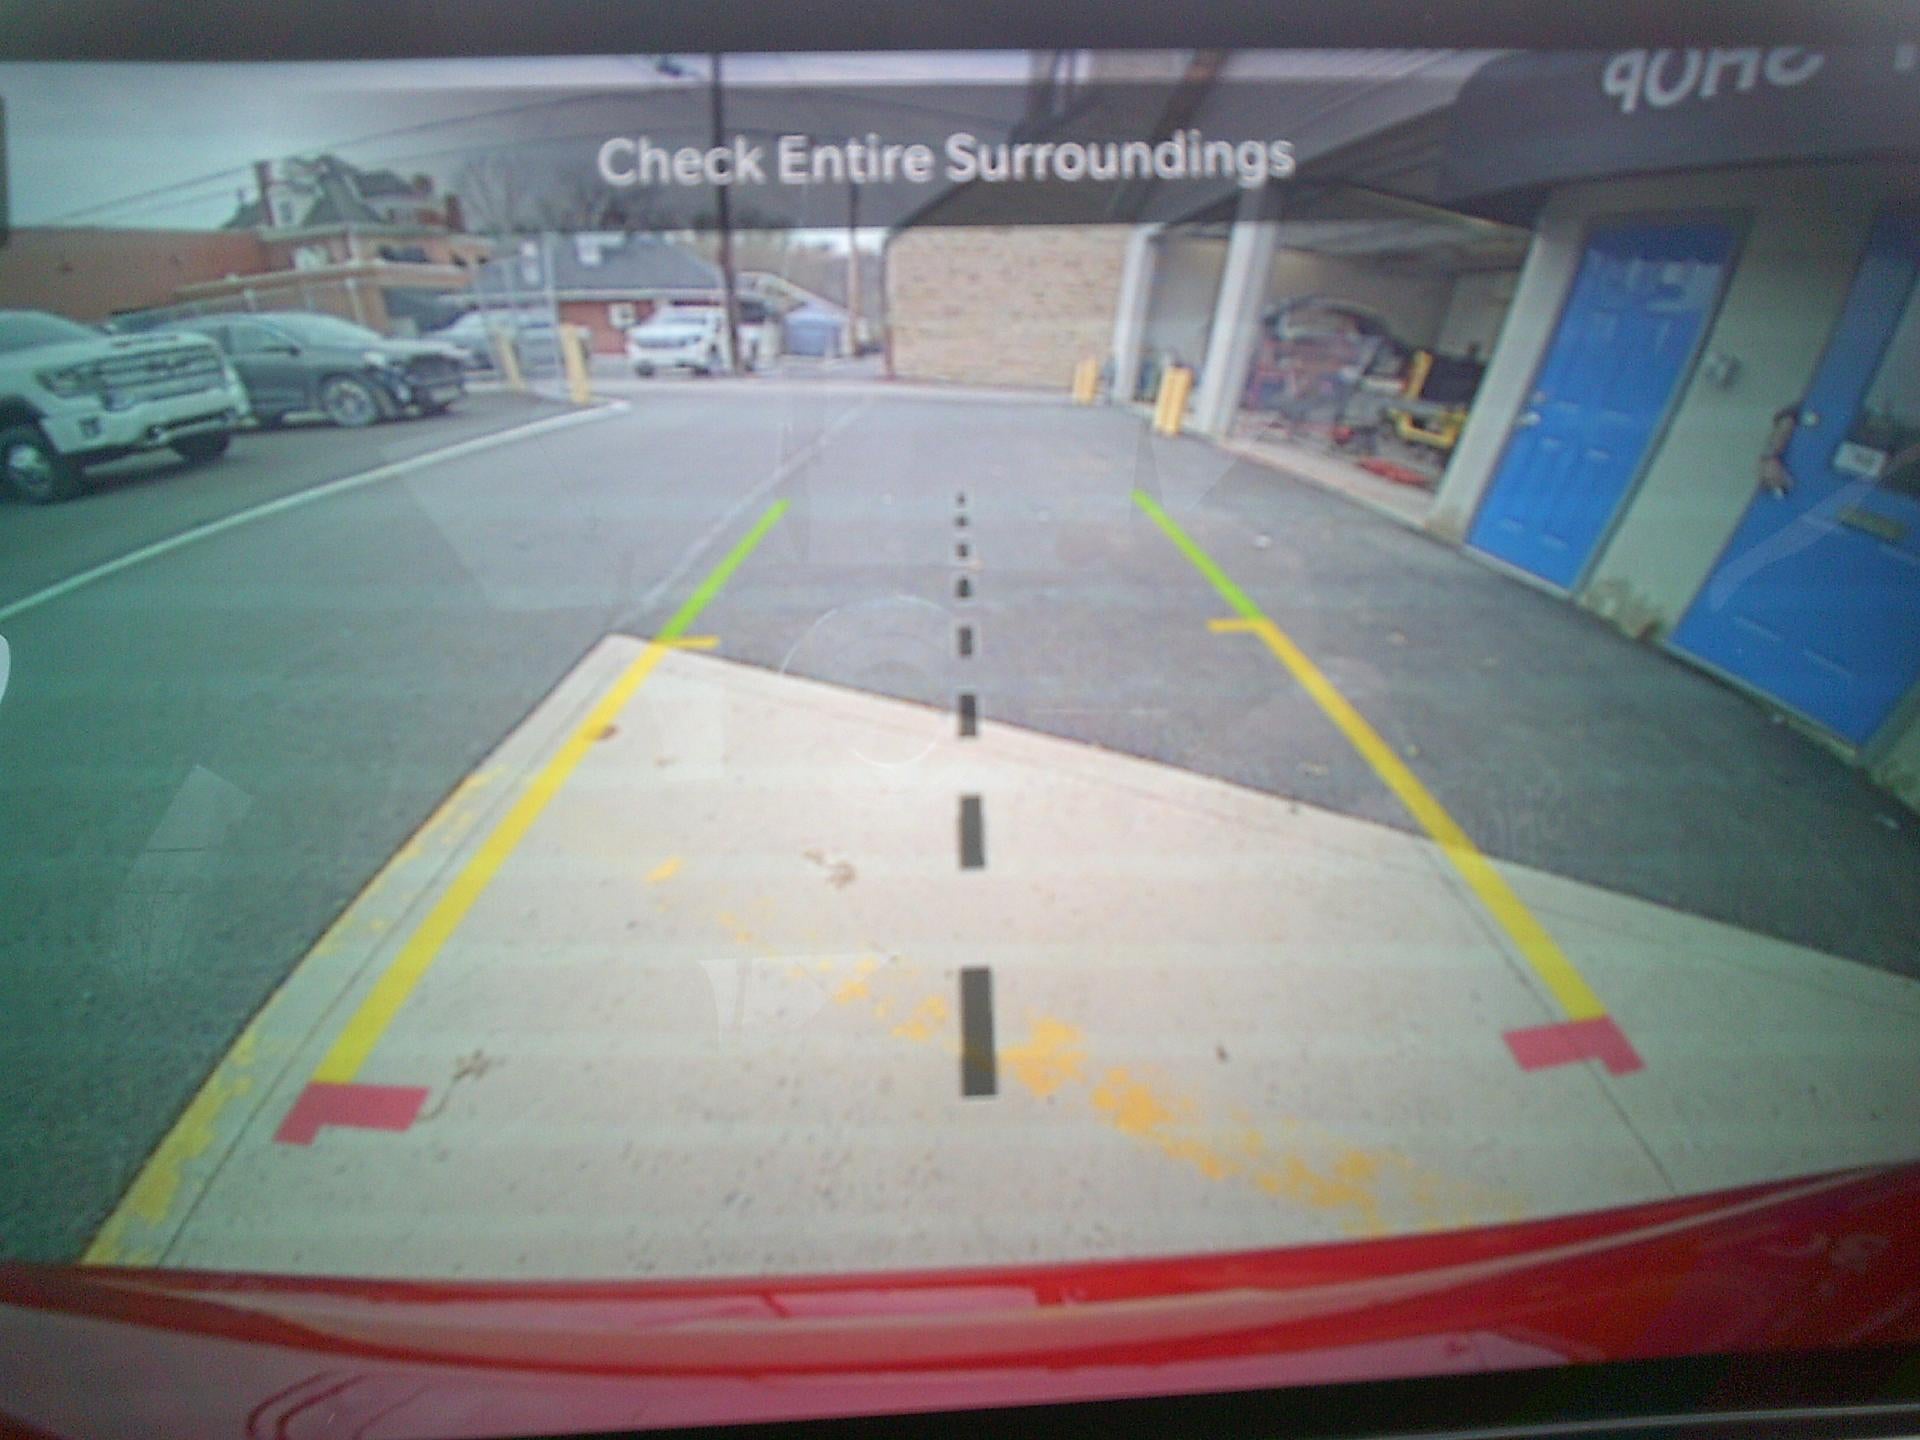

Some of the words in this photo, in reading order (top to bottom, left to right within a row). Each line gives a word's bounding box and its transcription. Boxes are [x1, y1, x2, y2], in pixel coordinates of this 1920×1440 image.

[598, 136, 765, 186] Check
[778, 133, 935, 184] Entire
[944, 129, 1296, 187] Surroundings
